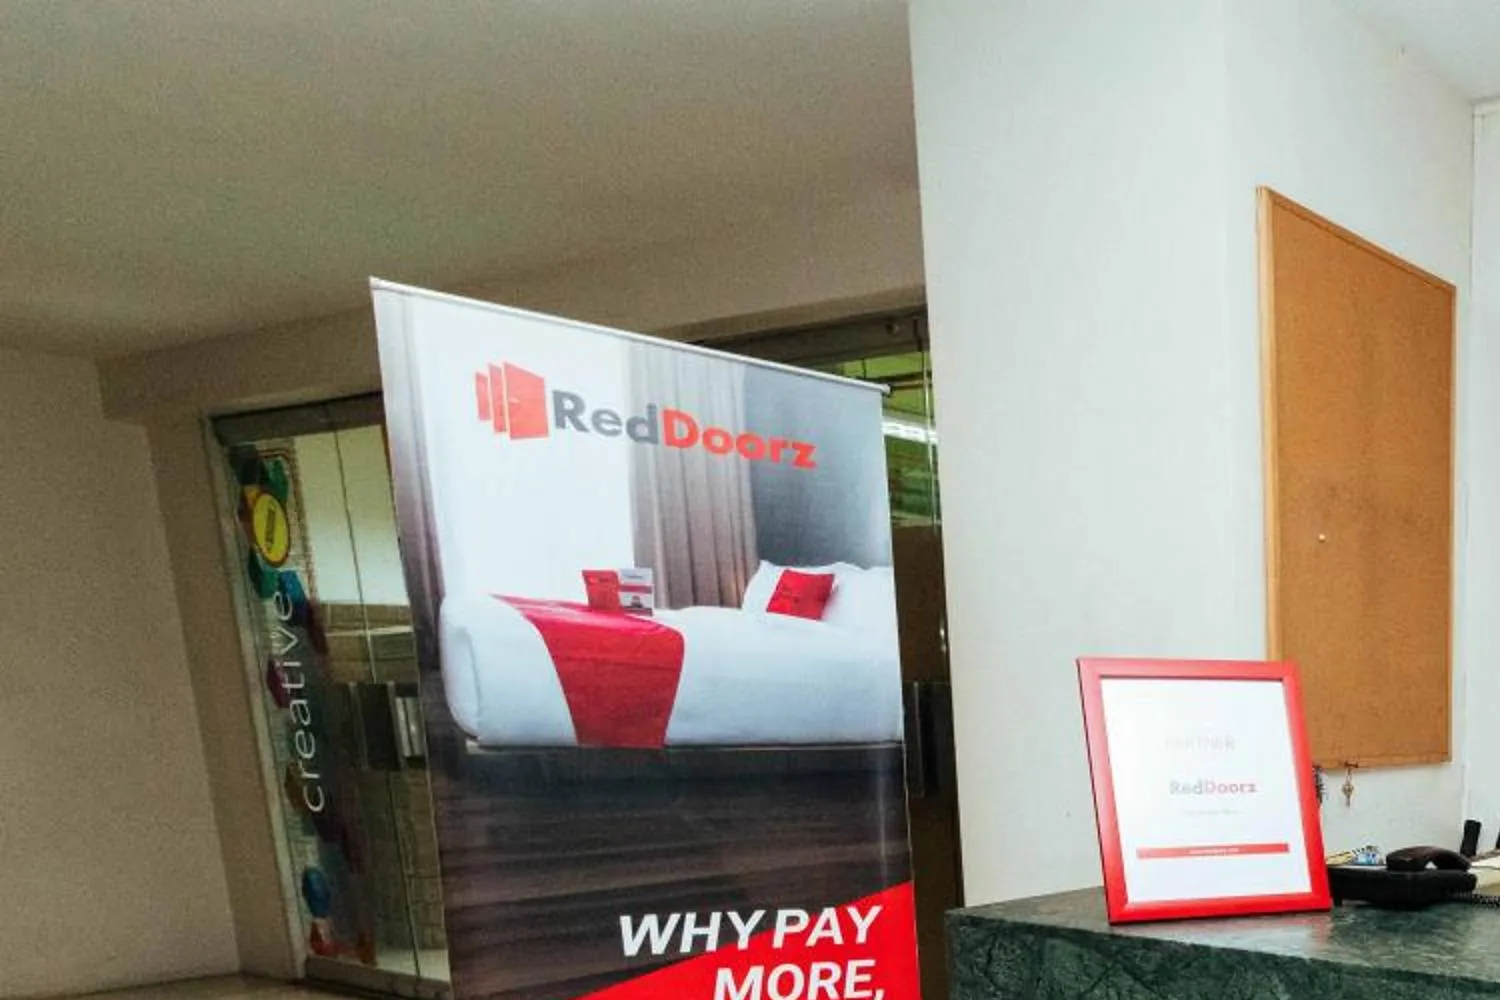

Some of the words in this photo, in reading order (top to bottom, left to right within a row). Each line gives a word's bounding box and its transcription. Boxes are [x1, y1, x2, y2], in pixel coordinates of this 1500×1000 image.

[551, 389, 818, 470] RedDoorz
[271, 590, 326, 812] creative
[1168, 777, 1258, 796] RedDoorz
[619, 908, 767, 957] WHY
[772, 905, 883, 949] PAY
